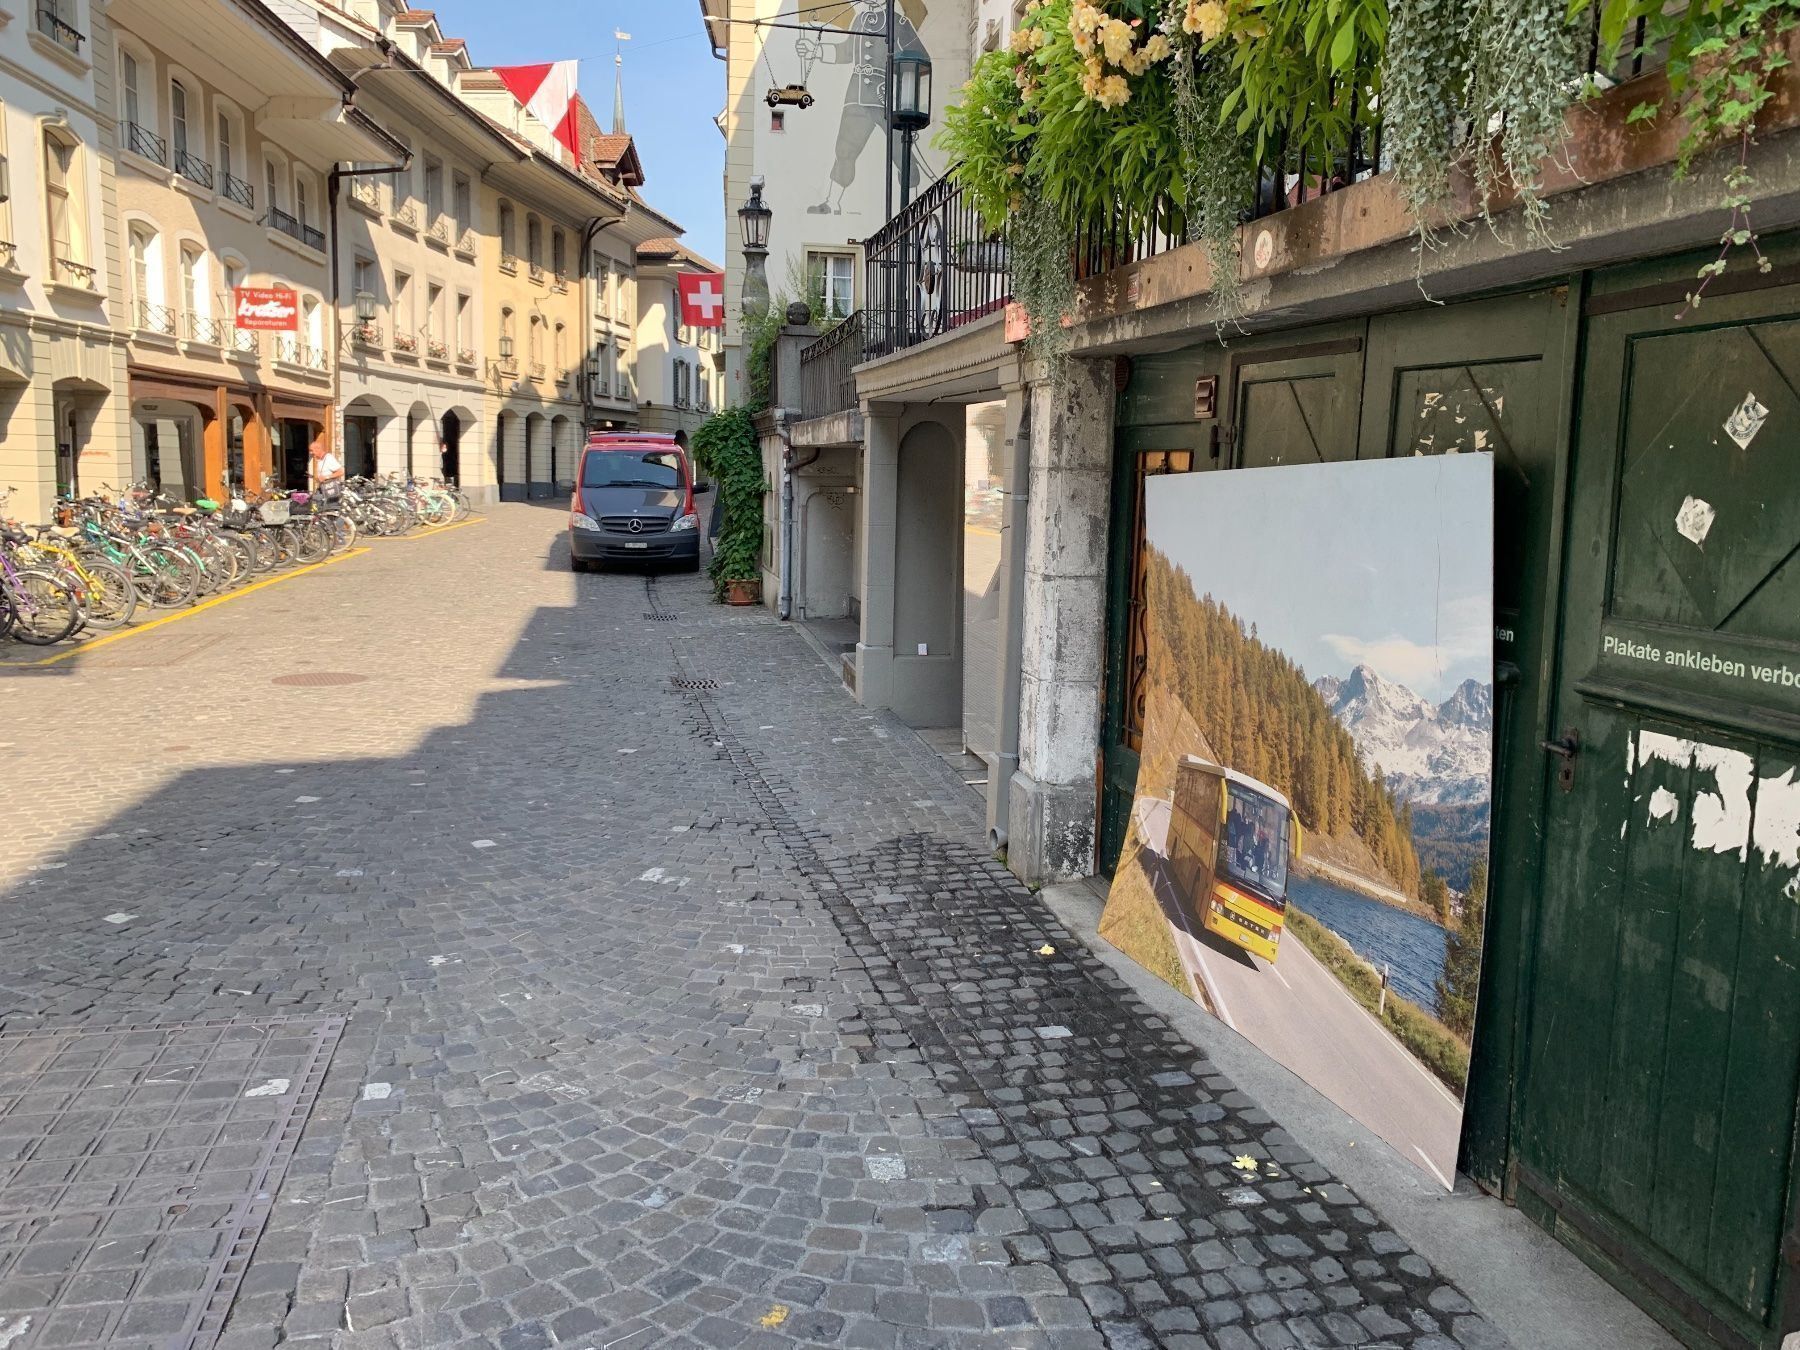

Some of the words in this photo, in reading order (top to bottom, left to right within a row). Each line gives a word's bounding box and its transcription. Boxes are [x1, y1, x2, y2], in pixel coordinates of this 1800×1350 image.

[240, 290, 250, 298] TV
[253, 291, 273, 299] Video
[276, 292, 292, 300] Hi-Fi
[244, 318, 288, 327] Reparaturen
[1603, 635, 1661, 662] Plakate
[1664, 650, 1745, 678] ankleben
